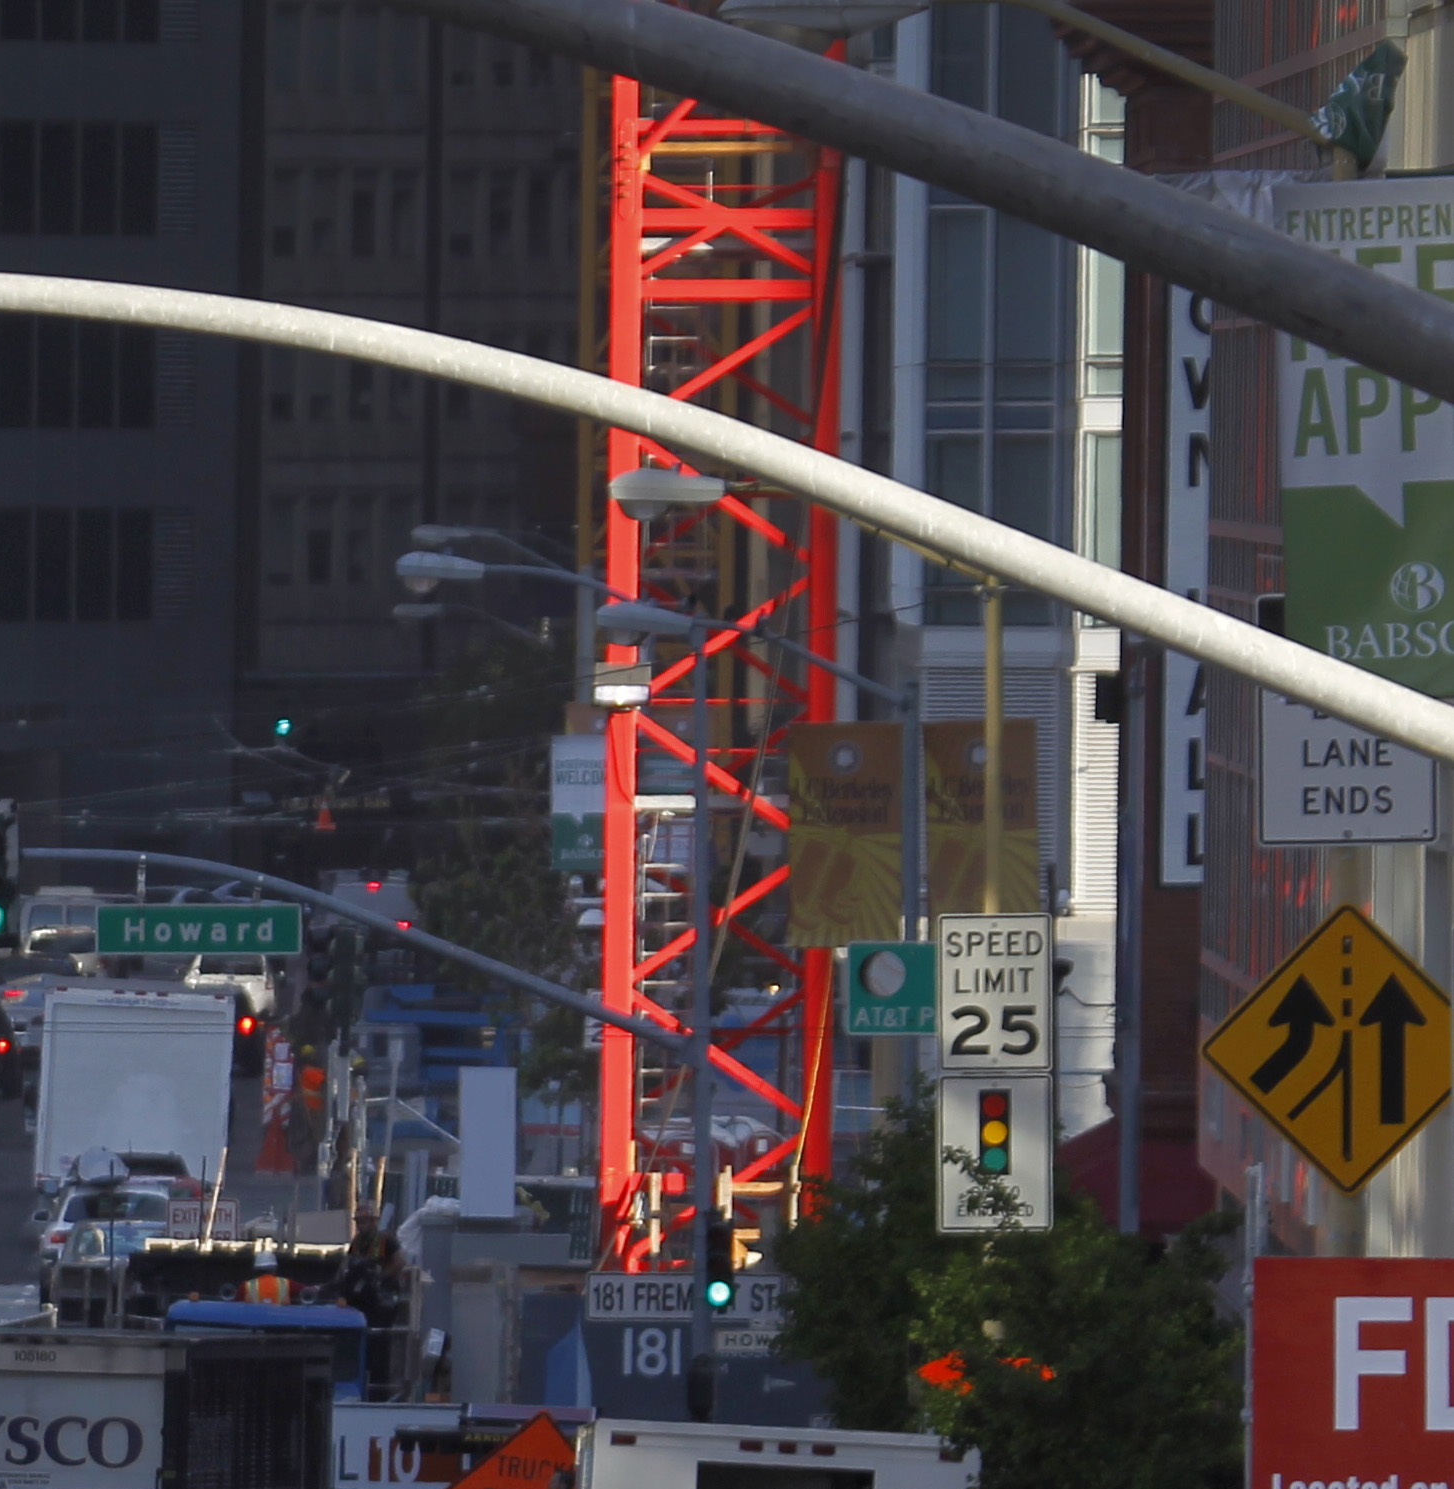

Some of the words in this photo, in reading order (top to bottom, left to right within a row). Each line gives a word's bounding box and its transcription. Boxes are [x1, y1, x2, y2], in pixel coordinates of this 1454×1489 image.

[1302, 739, 1393, 767] LANE
[1302, 785, 1393, 816] ENDS
[123, 917, 274, 943] Howard
[946, 930, 1044, 958] SPEED
[955, 967, 1035, 994] LIMIT
[854, 1006, 908, 1027] AT&T
[950, 1004, 1041, 1055] 25
[173, 1207, 199, 1224] EXIT
[593, 1282, 625, 1312] 181
[14, 1350, 57, 1362] 105180
[623, 1327, 681, 1375] 181
